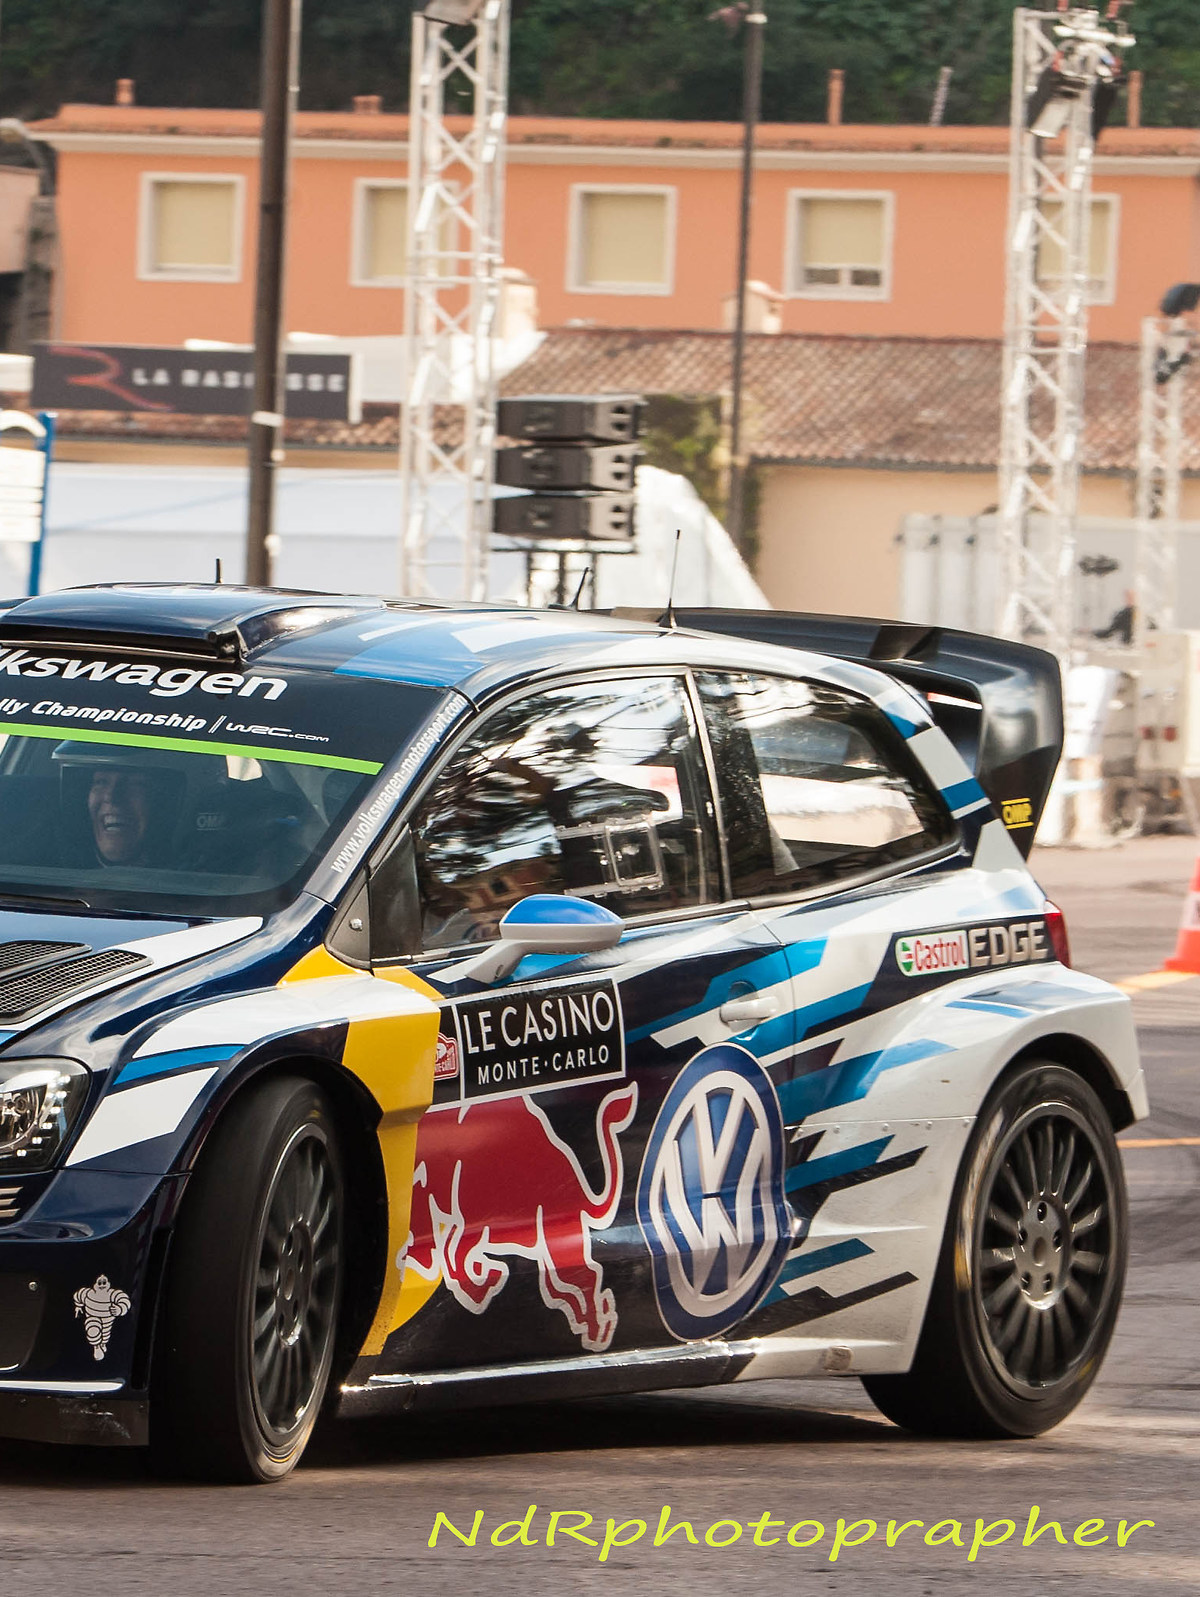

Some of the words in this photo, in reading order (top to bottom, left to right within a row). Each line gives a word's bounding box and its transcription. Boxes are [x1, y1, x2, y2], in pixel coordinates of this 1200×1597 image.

[131, 367, 170, 386] LA
[181, 369, 346, 393] RASCSSE
[31, 700, 207, 733] Championship
[331, 694, 468, 874] www.volkswagen-motorsport.com
[1002, 801, 1033, 825] OMP
[914, 934, 966, 971] Castrol
[969, 921, 1048, 967] EDGE
[463, 1010, 496, 1054] LE
[501, 991, 615, 1047] CASINO
